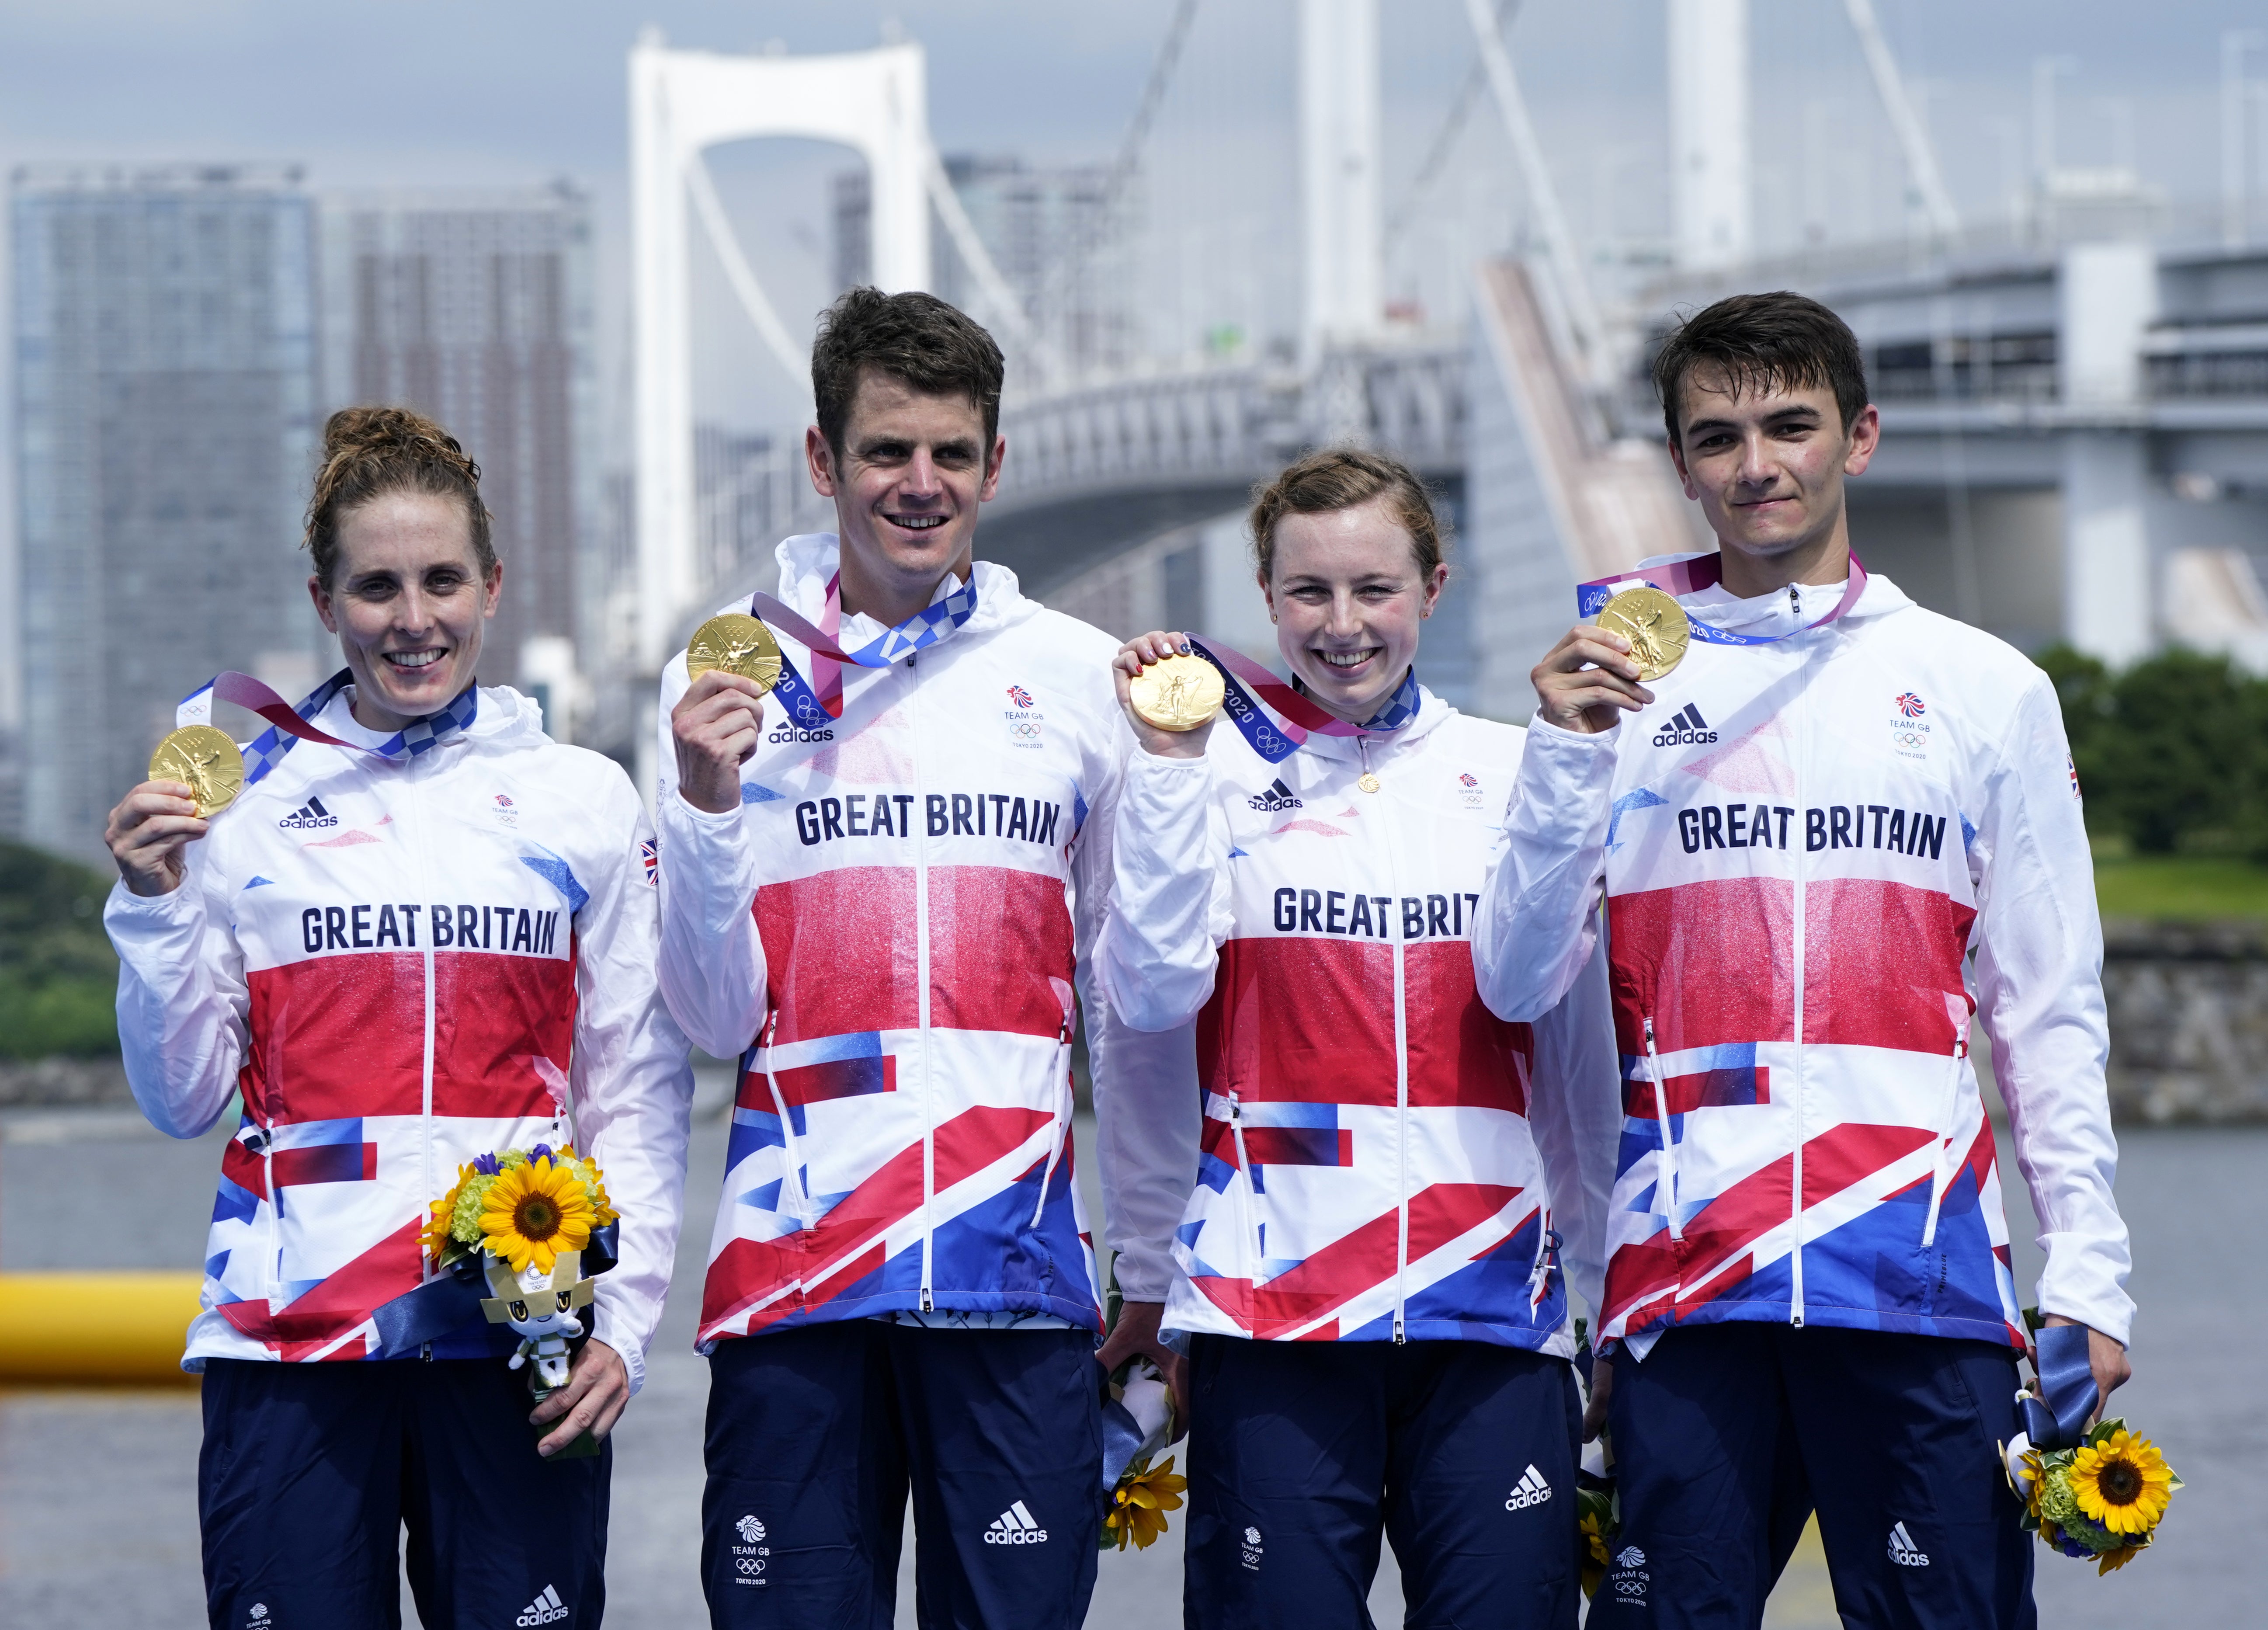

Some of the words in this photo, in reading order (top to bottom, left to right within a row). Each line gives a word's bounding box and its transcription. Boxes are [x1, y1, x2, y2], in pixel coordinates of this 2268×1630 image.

[1688, 621, 1710, 638] 020
[777, 665, 796, 693] 20
[1224, 688, 1254, 723] 2020
[1889, 719, 1915, 729] TEAM
[1918, 723, 1930, 732] GB
[768, 728, 834, 744] adidas
[1653, 729, 1718, 747] adidas
[1895, 748, 1911, 757] TOKYO
[1248, 798, 1303, 812] adidas
[279, 816, 338, 829] adidas
[795, 795, 914, 846] GREAT
[926, 794, 1060, 847] BRITAIN
[1678, 804, 1795, 854] GREAT
[1806, 805, 1946, 860] BRITAIN
[1274, 888, 1392, 938] GREAT
[1401, 893, 1480, 939] BRIT
[302, 904, 421, 953] GREAT
[431, 905, 558, 955] BRITAIN
[1505, 1487, 1552, 1511] adidas
[984, 1528, 1048, 1545] adidas
[732, 1546, 756, 1555] TEAM
[758, 1547, 770, 1556] GB
[1241, 1542, 1254, 1551] TEAM
[1887, 1548, 1930, 1566] adidas
[1611, 1571, 1636, 1581] TEAM
[1639, 1571, 1650, 1581] GB
[1635, 1599, 1646, 1607] 2020
[246, 1620, 261, 1629] TEAM
[516, 1606, 568, 1627] adidas
